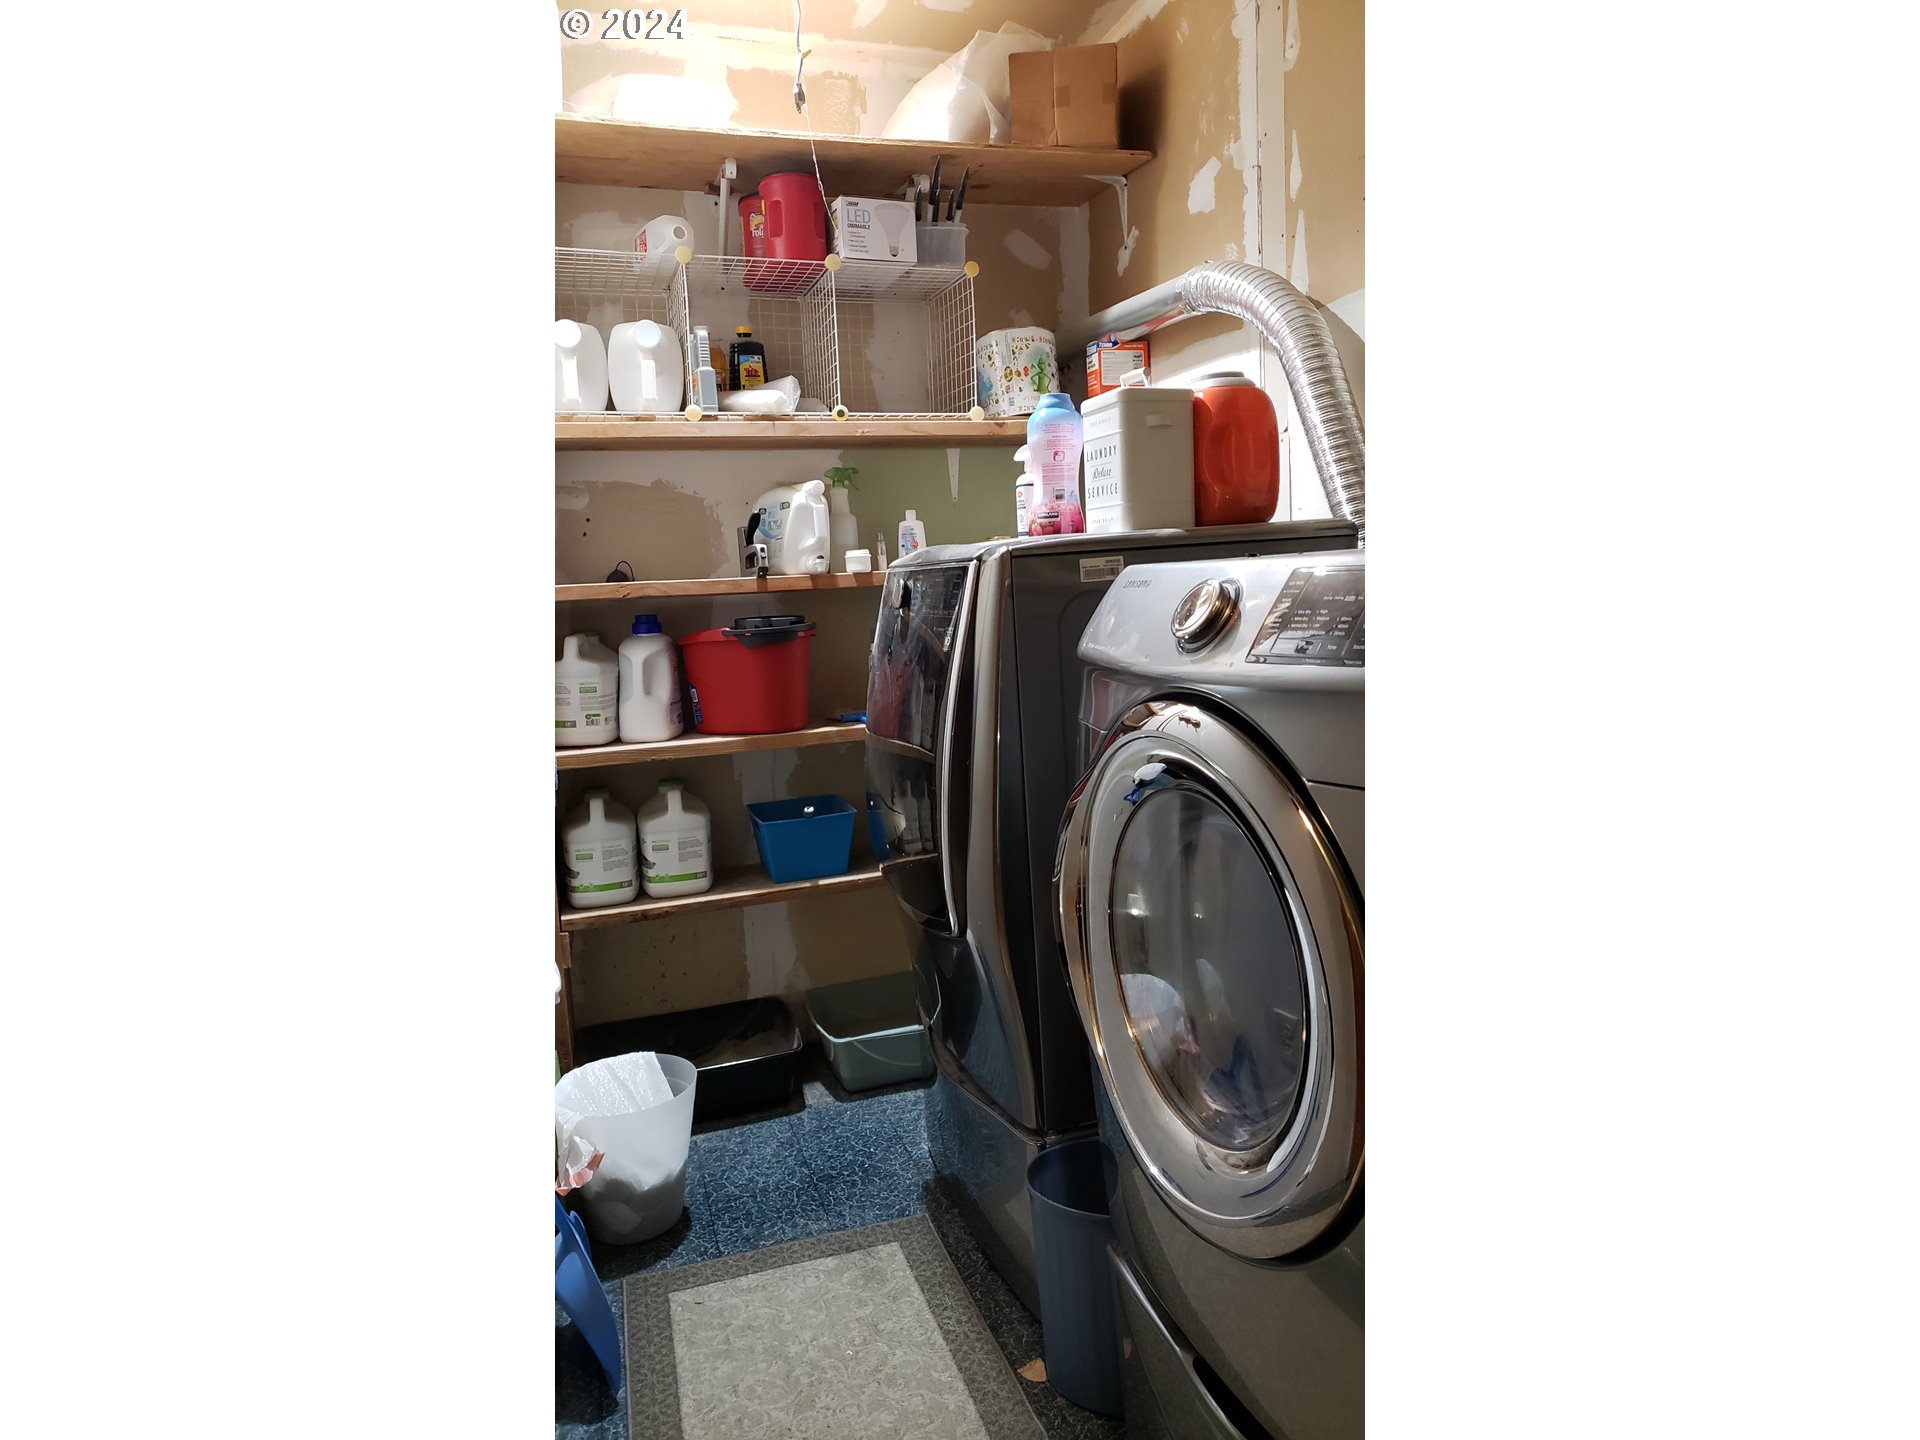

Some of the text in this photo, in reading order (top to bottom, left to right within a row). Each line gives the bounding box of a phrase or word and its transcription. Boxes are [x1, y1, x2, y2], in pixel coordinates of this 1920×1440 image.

[847, 208, 871, 224] LED
[1086, 444, 1117, 462] LAUNDRY
[1092, 467, 1112, 480] Deluxe
[1087, 482, 1118, 499] SERVICE
[1123, 579, 1153, 589] SAMSUNG
